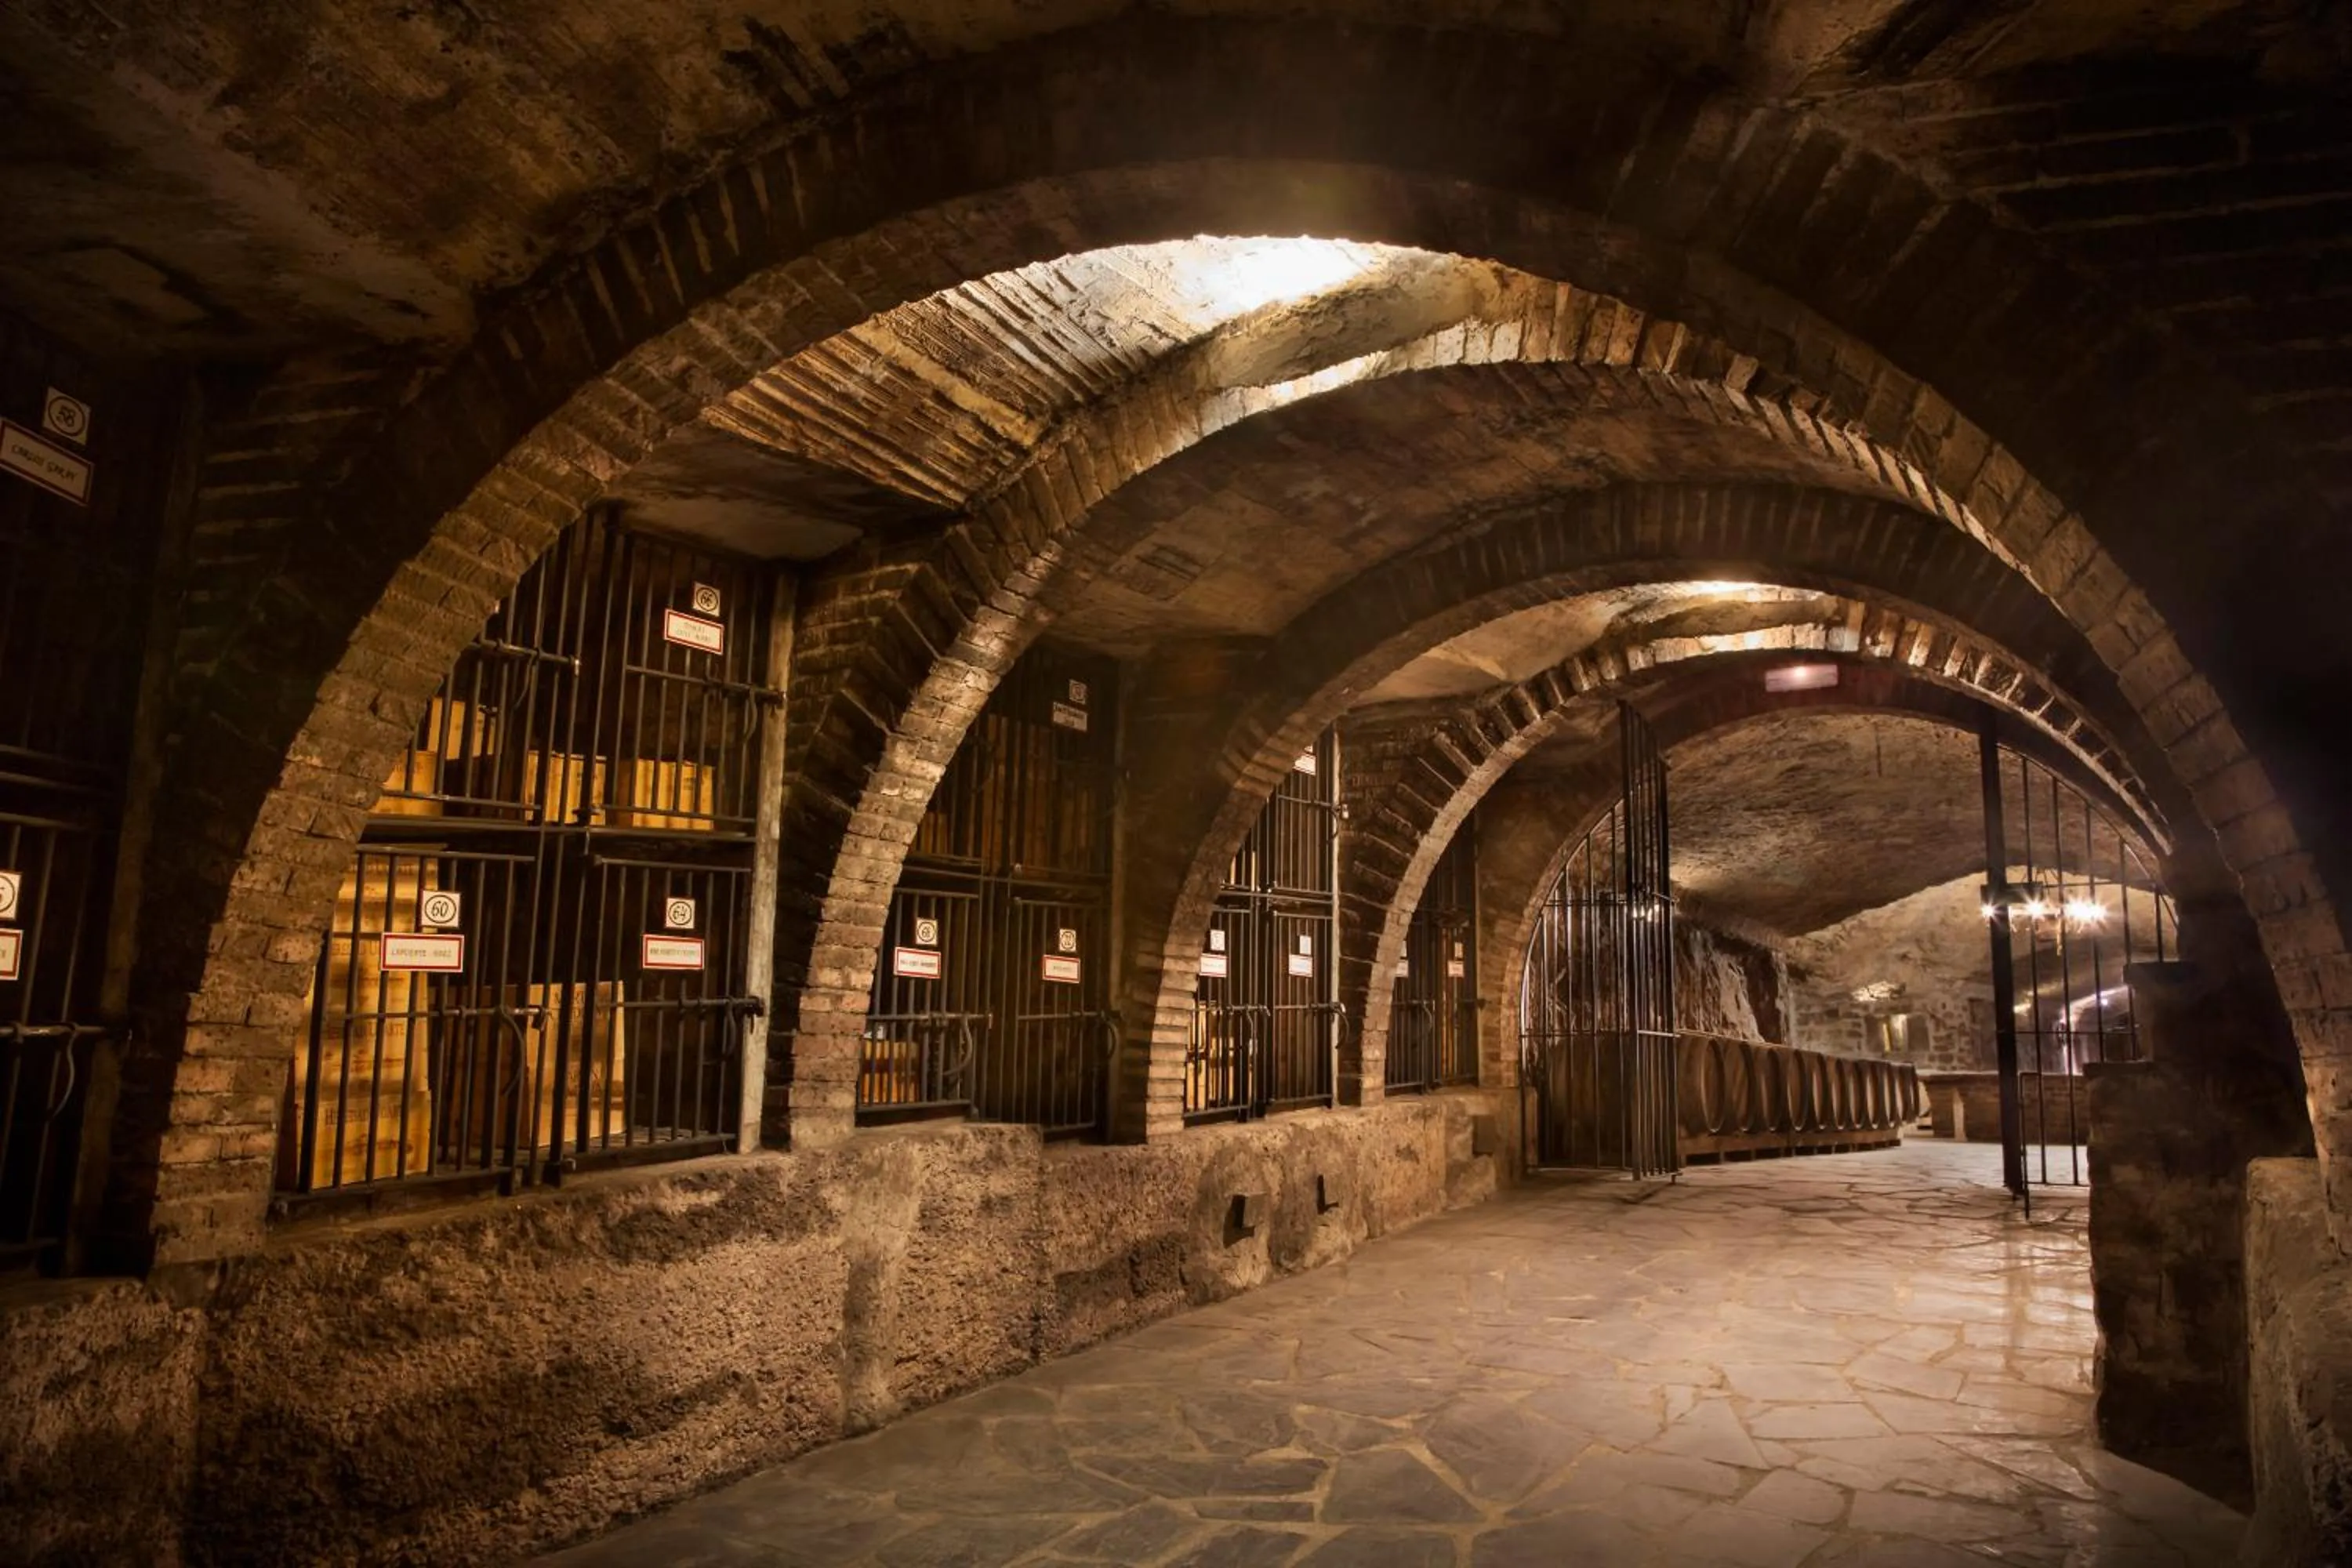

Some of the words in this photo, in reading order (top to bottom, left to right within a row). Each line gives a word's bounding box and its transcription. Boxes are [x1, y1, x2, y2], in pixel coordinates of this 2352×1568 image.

[56, 406, 76, 428] 58
[431, 901, 448, 917] 60
[673, 905, 688, 920] 64
